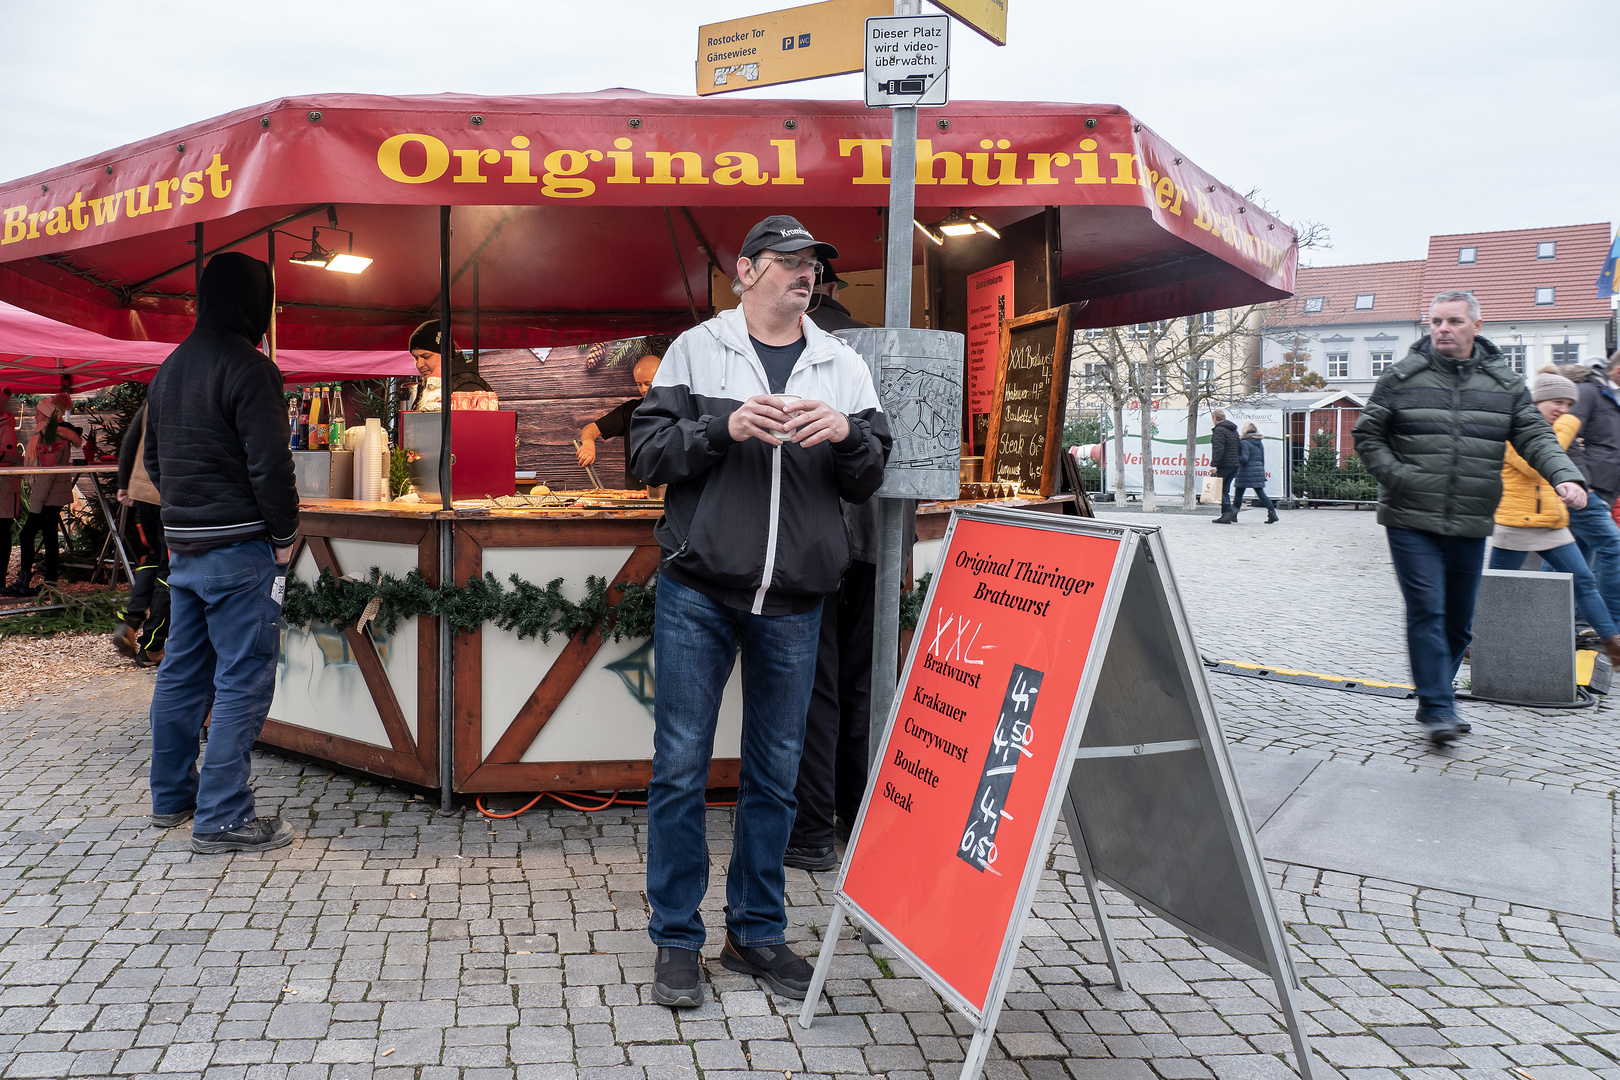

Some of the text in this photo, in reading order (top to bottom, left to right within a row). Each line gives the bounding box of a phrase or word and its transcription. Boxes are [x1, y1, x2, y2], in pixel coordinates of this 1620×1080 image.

[707, 28, 765, 46] Rostocker Tor
[784, 36, 810, 50] P WC
[873, 27, 942, 39] Dieser Platz
[874, 42, 939, 52] wird video-
[707, 47, 757, 62] Gänsewiese
[875, 54, 938, 66] überwacht.
[377, 132, 804, 199] Original
[1, 152, 232, 246] Bratwurst
[999, 432, 1024, 457] Steak
[955, 550, 1094, 597] Original Thüringer
[973, 582, 1050, 617] Bratwurst
[923, 653, 982, 689] Bratwurst
[913, 686, 967, 723] Krakauer
[904, 717, 968, 763] Currywurst
[893, 749, 940, 788] Boulette
[883, 782, 914, 814] Steak
